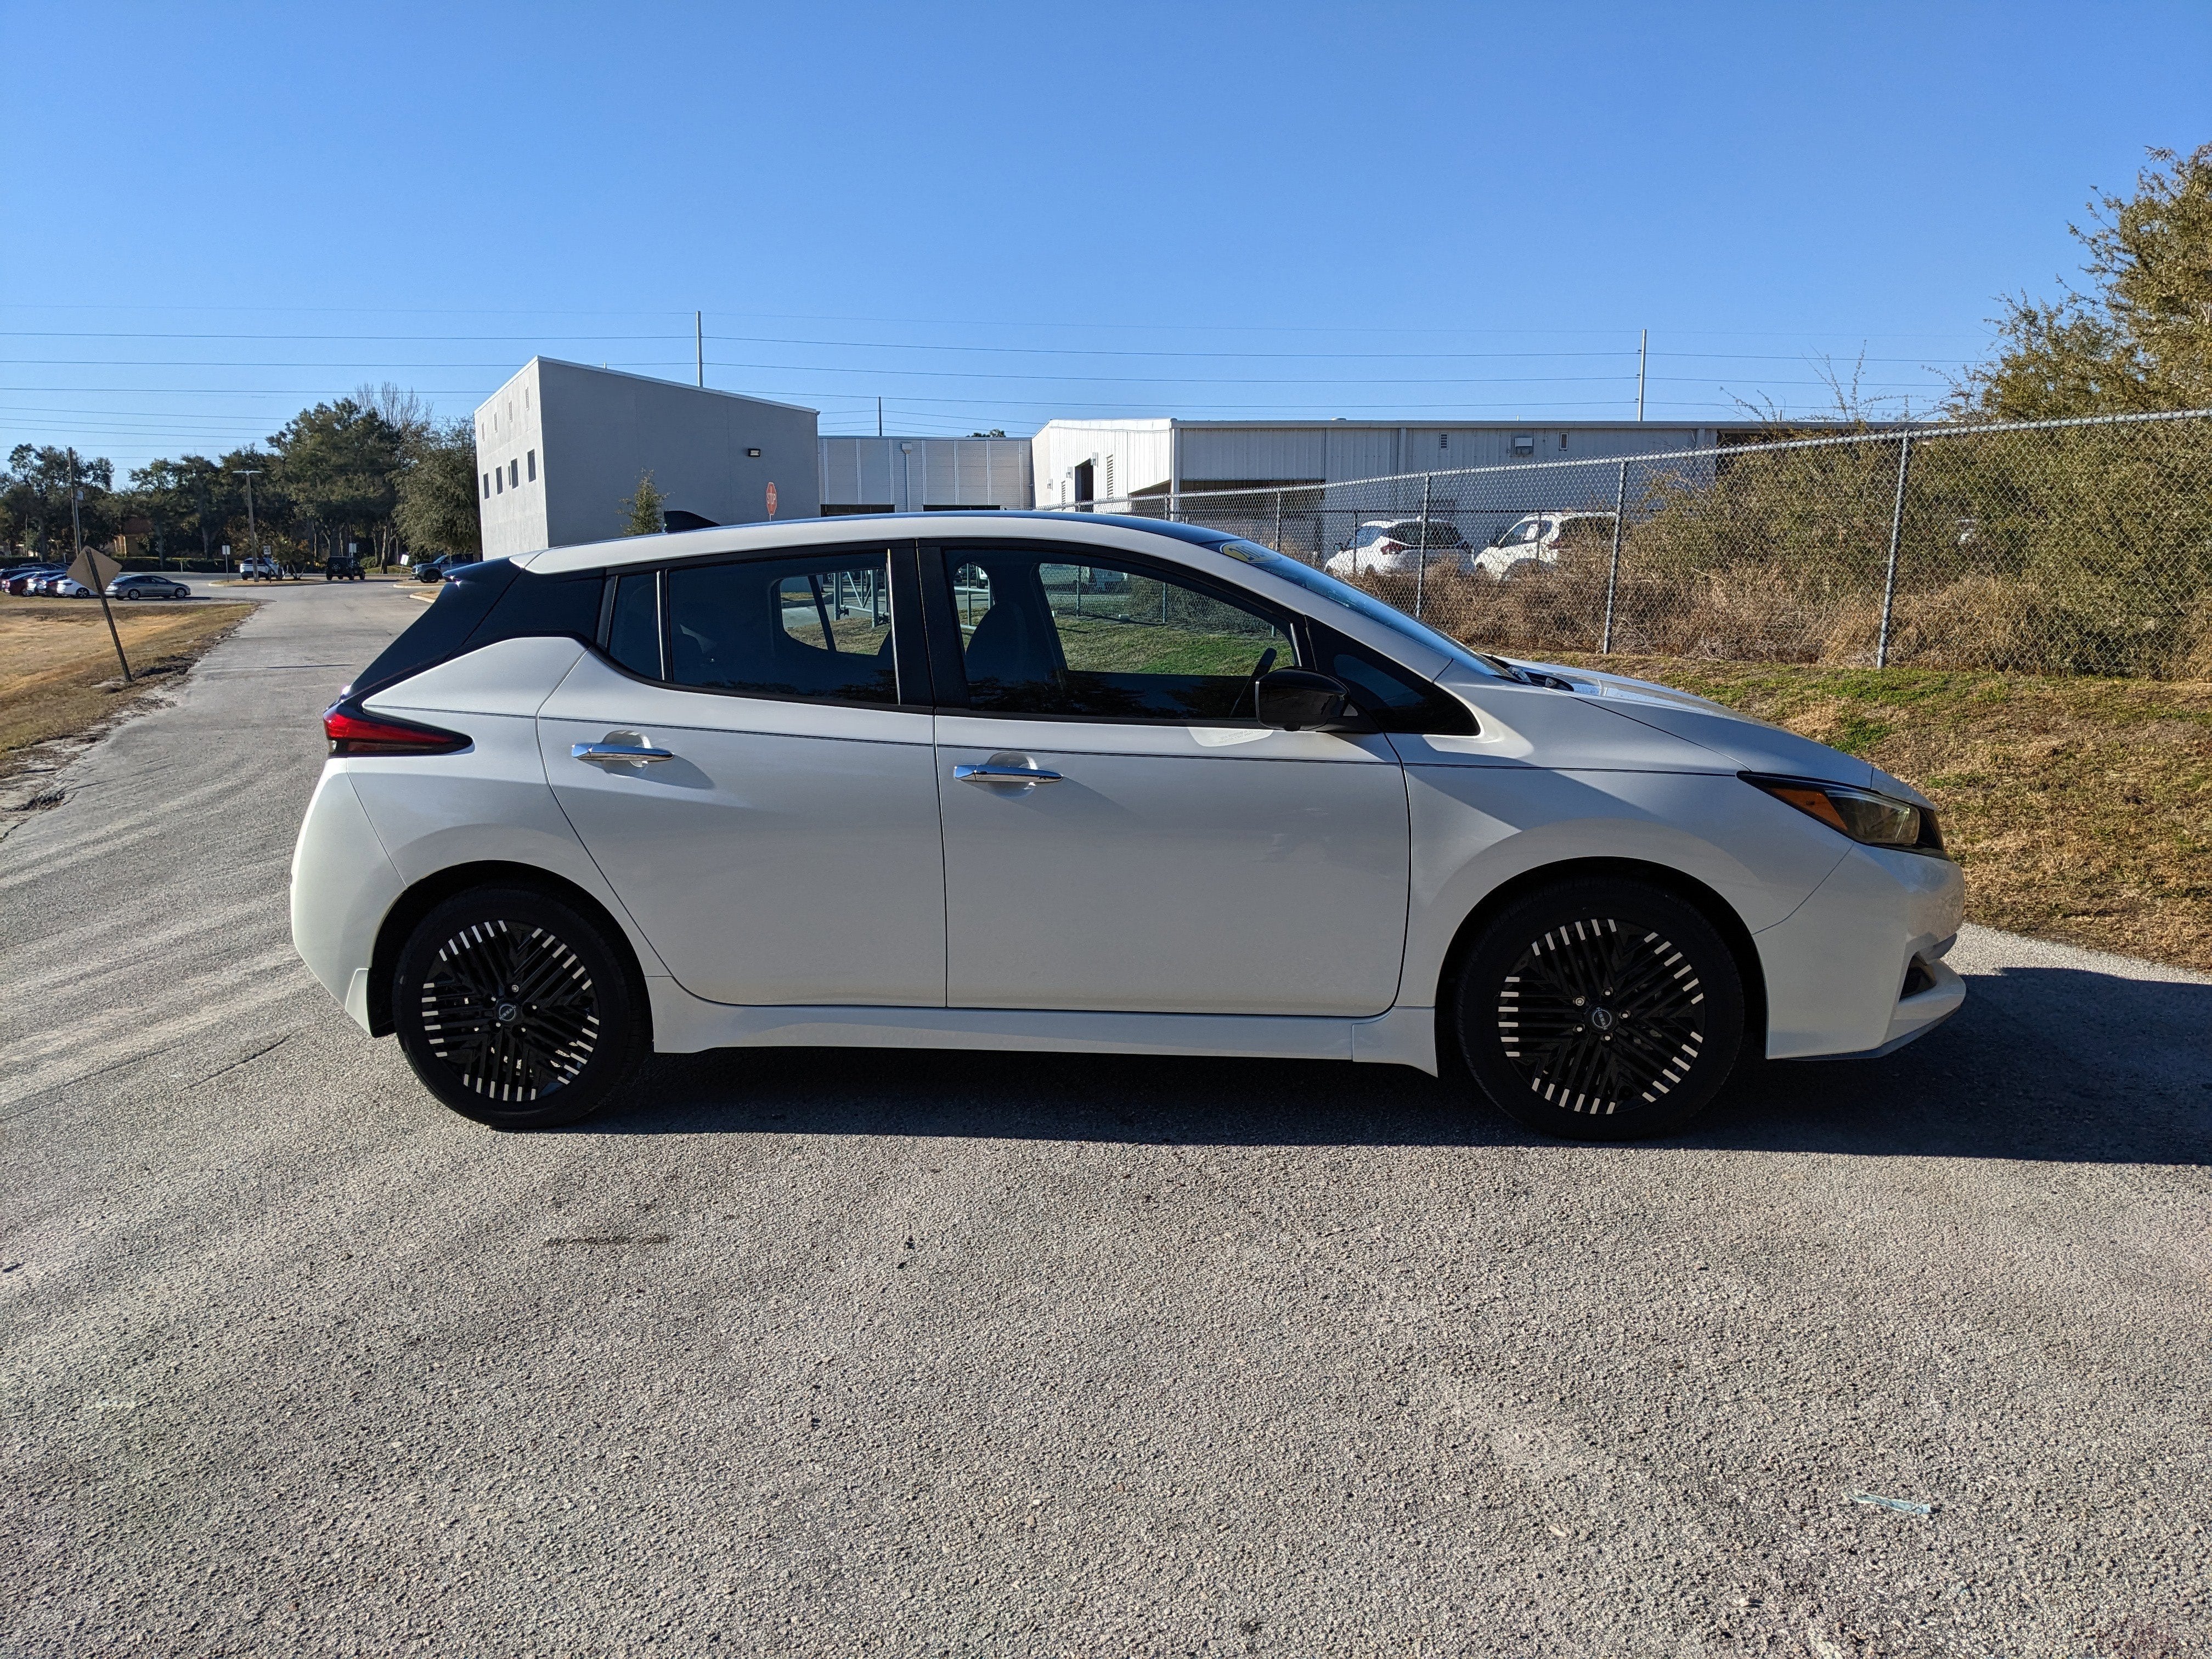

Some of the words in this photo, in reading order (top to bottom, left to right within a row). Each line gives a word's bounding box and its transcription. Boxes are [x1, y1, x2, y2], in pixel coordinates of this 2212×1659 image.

[767, 493, 776, 505] STOP
[499, 1005, 516, 1020] NISSAN
[1596, 1007, 1608, 1030] NISSAN
